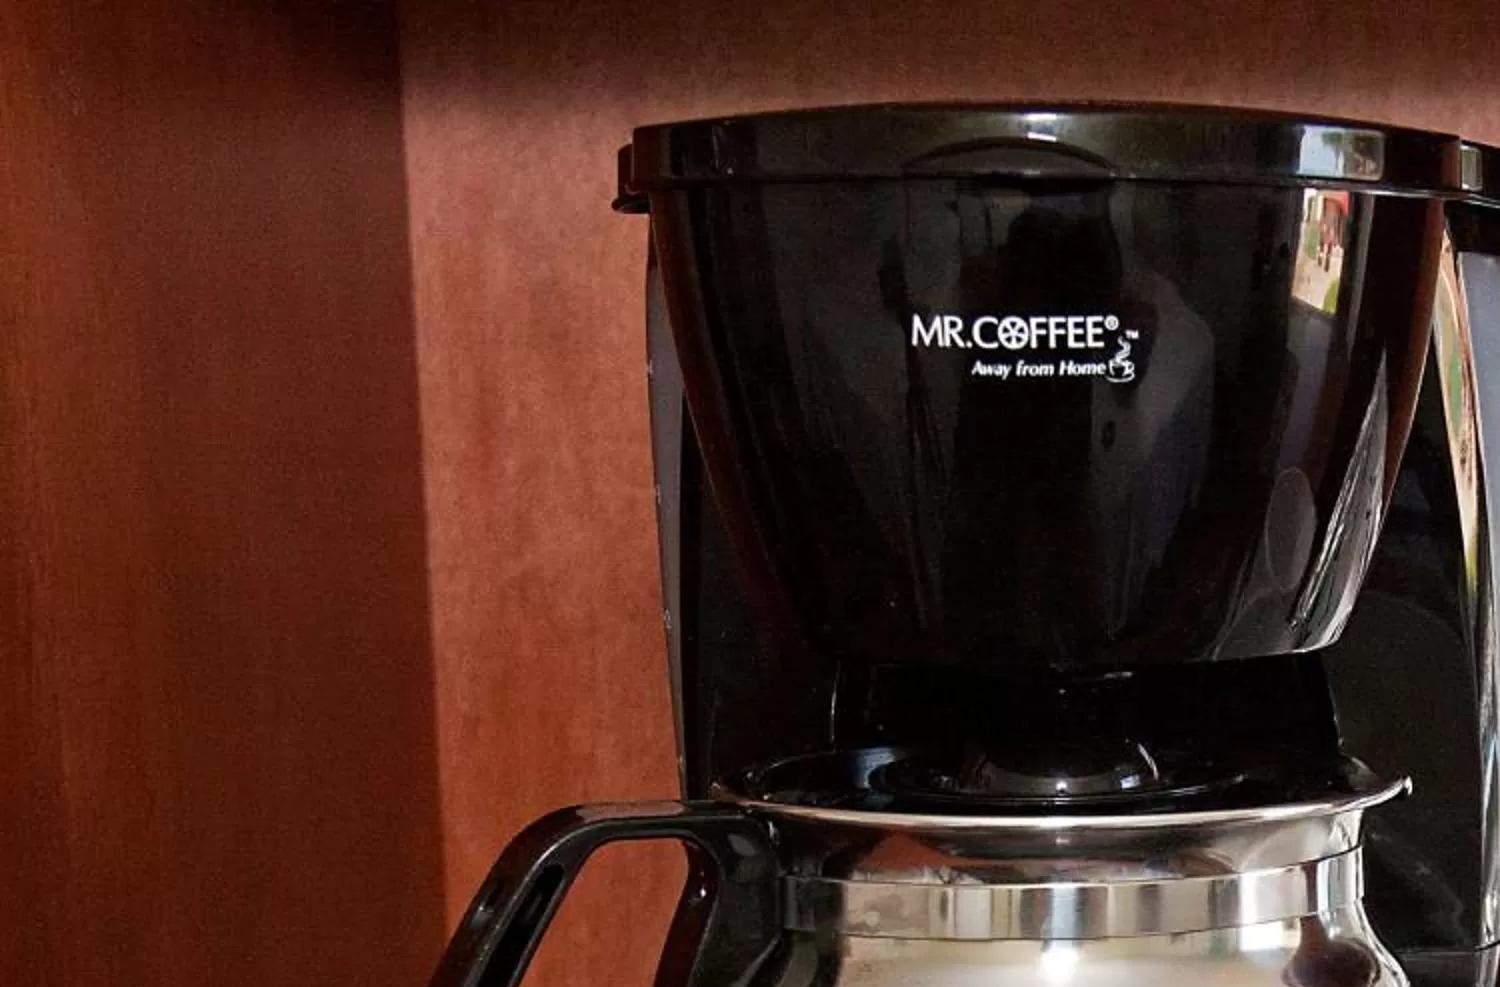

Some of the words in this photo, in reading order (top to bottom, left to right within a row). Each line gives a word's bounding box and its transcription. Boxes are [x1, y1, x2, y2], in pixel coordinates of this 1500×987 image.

[971, 360, 1011, 380] Away
[1015, 359, 1054, 377] from
[1059, 360, 1106, 376] Home
